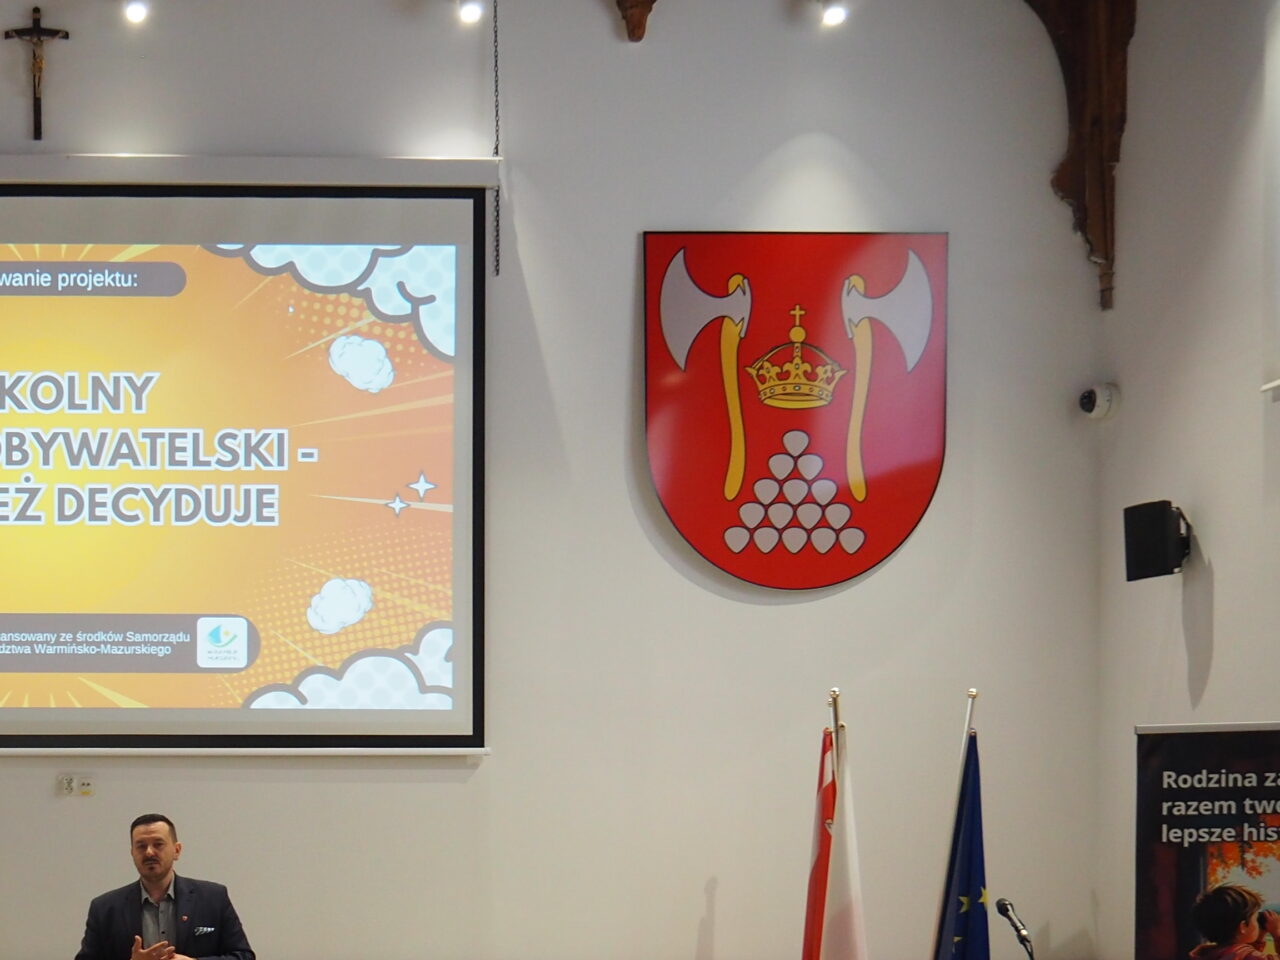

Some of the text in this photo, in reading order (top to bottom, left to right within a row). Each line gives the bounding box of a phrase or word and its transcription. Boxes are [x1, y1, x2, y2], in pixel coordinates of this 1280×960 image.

[57, 268, 138, 292] projektu:
[55, 483, 280, 526] DECYDUJE
[59, 633, 73, 642] ze
[75, 630, 124, 643] środków
[126, 631, 191, 645] Samorządu
[34, 643, 171, 657] Warmińsko-Mazurskiego
[1162, 769, 1280, 788] Rodzina z
[1163, 801, 1236, 815] razem
[1163, 823, 1280, 847] lepsze his
